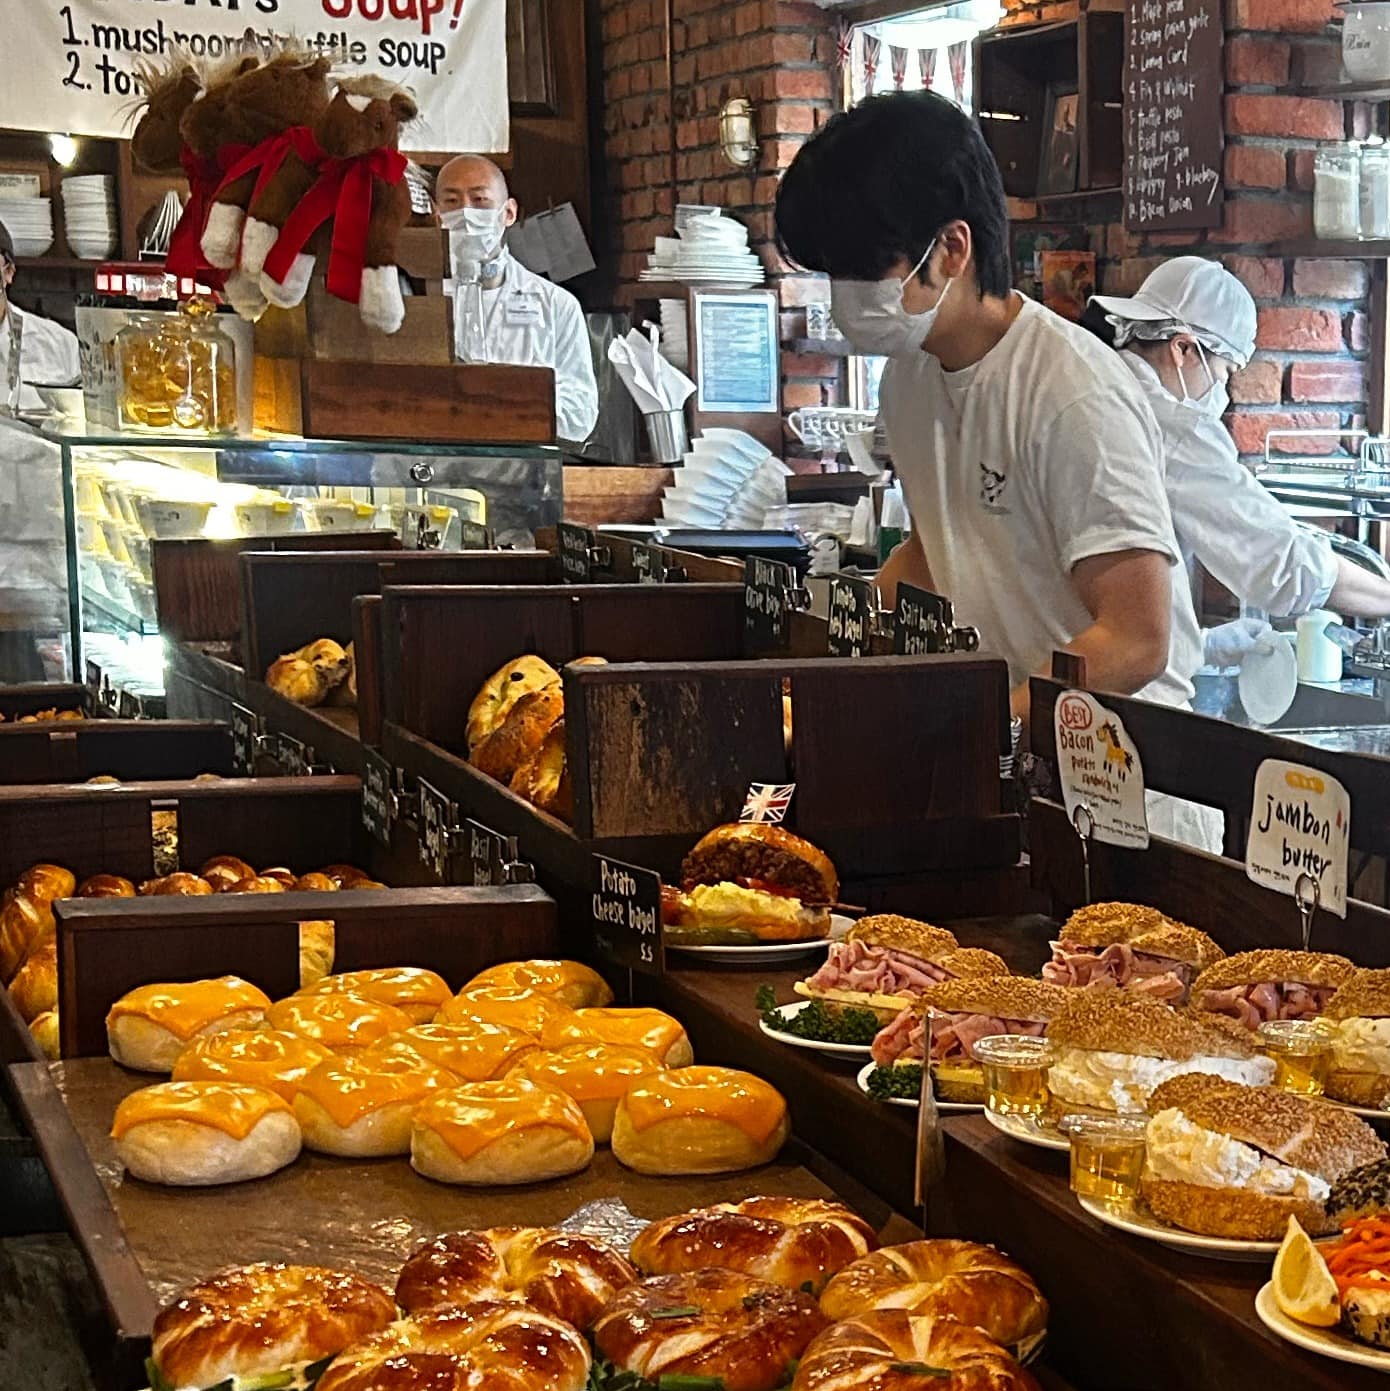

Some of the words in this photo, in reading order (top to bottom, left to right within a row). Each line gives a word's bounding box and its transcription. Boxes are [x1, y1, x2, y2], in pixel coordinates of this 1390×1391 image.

[378, 37, 447, 75] soup
[1064, 702, 1087, 726] BEST
[1059, 724, 1095, 753] Bacon
[1282, 837, 1333, 881] butter
